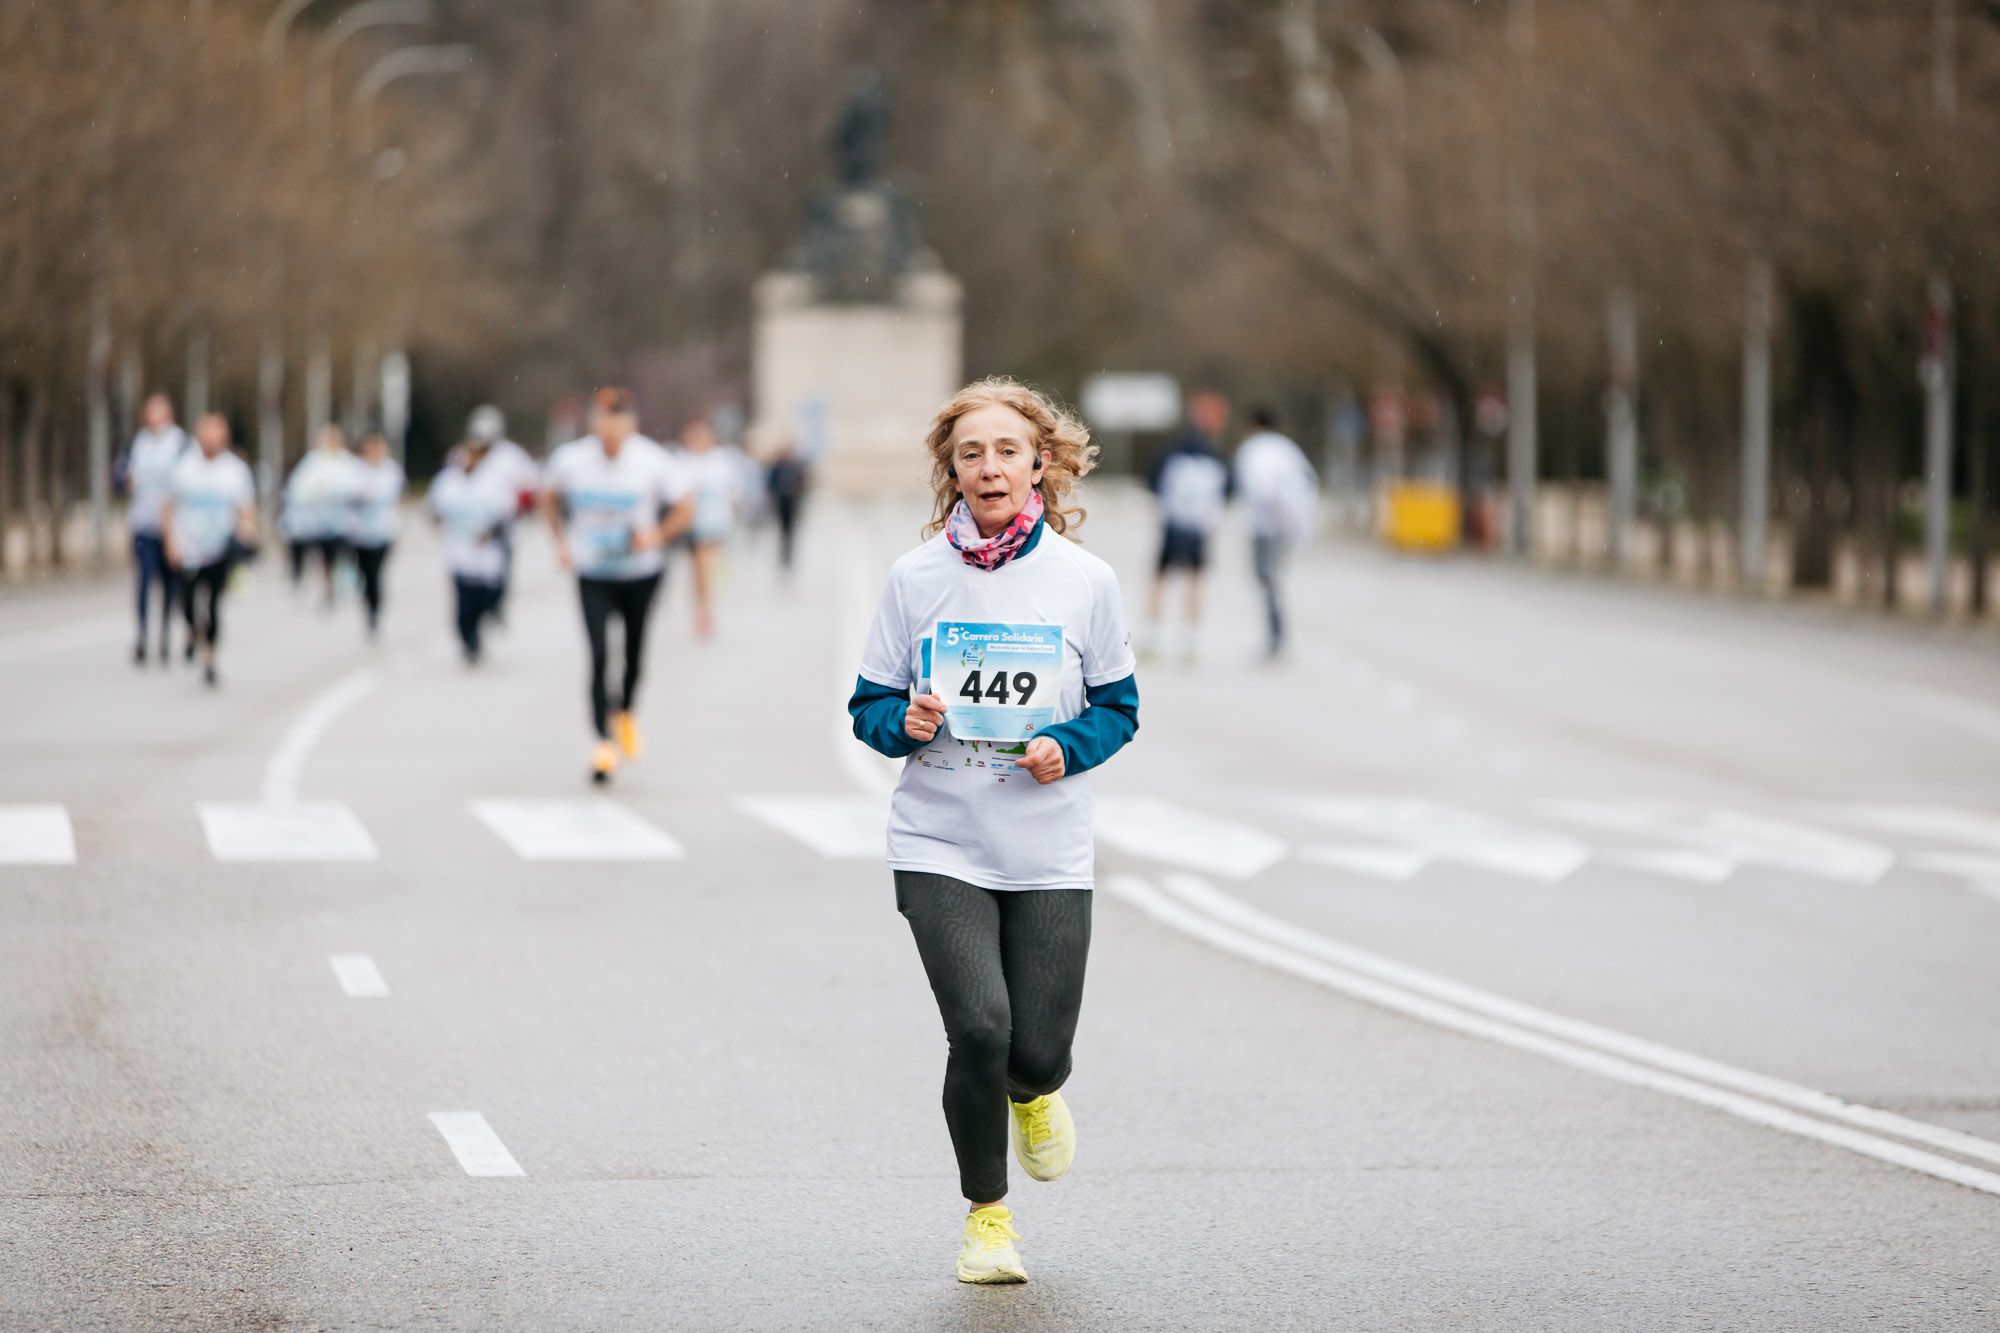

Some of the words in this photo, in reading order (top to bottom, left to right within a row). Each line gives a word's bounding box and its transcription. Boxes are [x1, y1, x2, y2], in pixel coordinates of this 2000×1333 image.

[962, 631, 999, 642] Carrera
[1001, 631, 1044, 643] Solidaria
[959, 670, 1037, 705] 449
